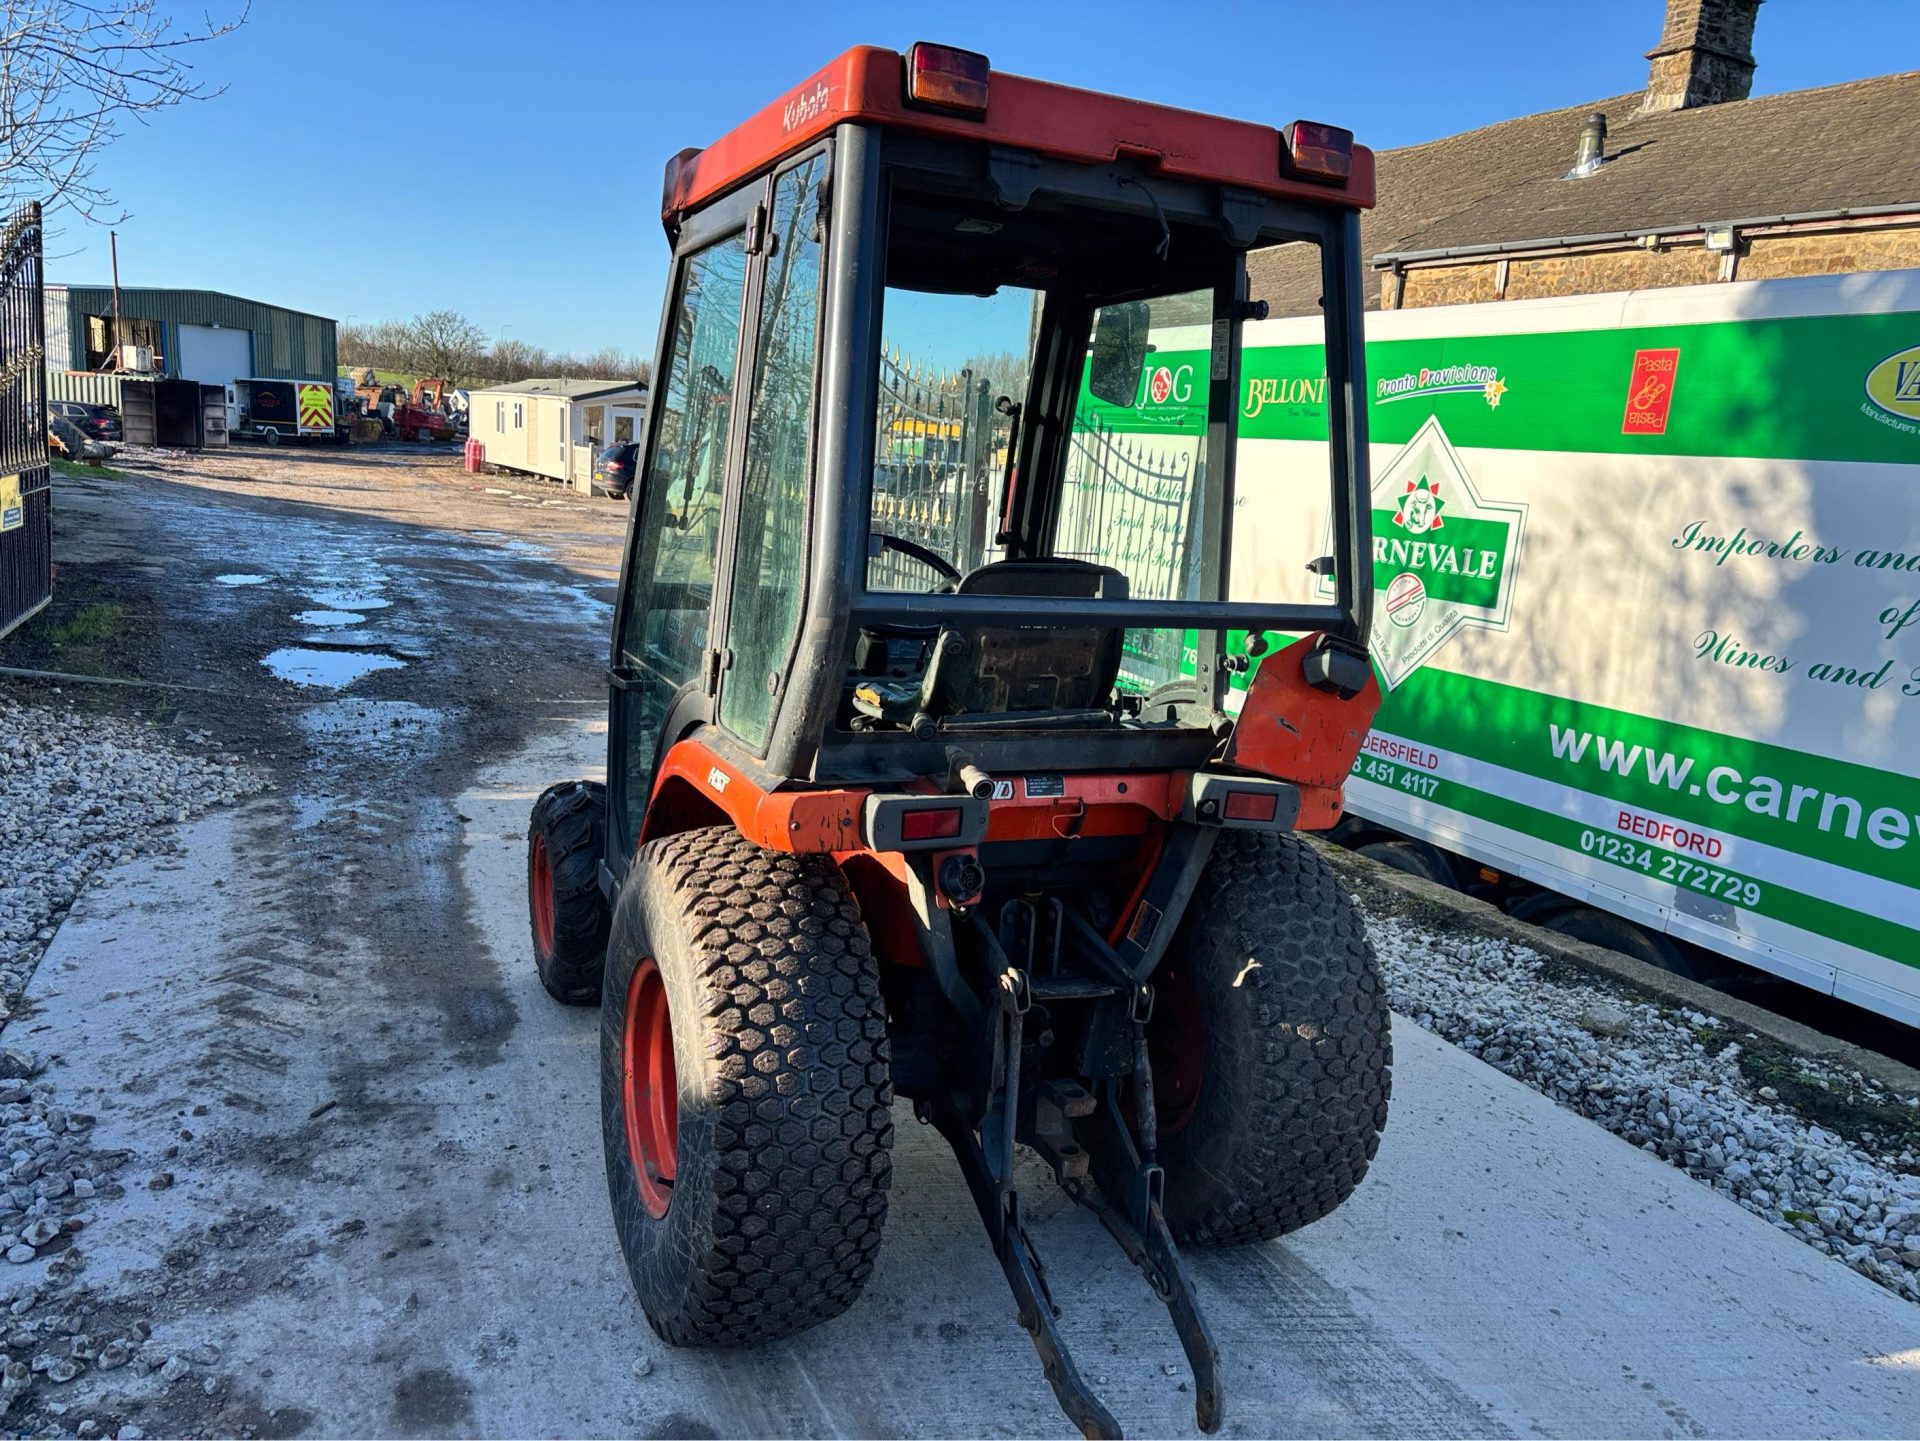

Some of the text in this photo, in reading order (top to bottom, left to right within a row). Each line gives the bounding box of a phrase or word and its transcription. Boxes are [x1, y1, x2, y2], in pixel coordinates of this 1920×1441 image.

[783, 82, 829, 132] Kubota
[1376, 363, 1498, 398] Pronto Provisions
[1636, 356, 1673, 373] Pasta
[1241, 378, 1326, 418] BELLONI
[1628, 412, 1665, 428] Pasta
[1860, 402, 1916, 434] Manufacturers
[1671, 520, 1849, 566] Importers
[1401, 637, 1428, 665] Prodotti
[1427, 631, 1436, 642] di
[1693, 631, 1798, 673] Wines
[1808, 660, 1894, 689] and
[707, 766, 731, 793] HST
[1366, 761, 1395, 784] 451
[1400, 772, 1439, 797] 4117
[1550, 723, 1920, 850] www.carne
[1617, 811, 1722, 858] BEDFORD
[1580, 829, 1761, 906] 01234 272729
